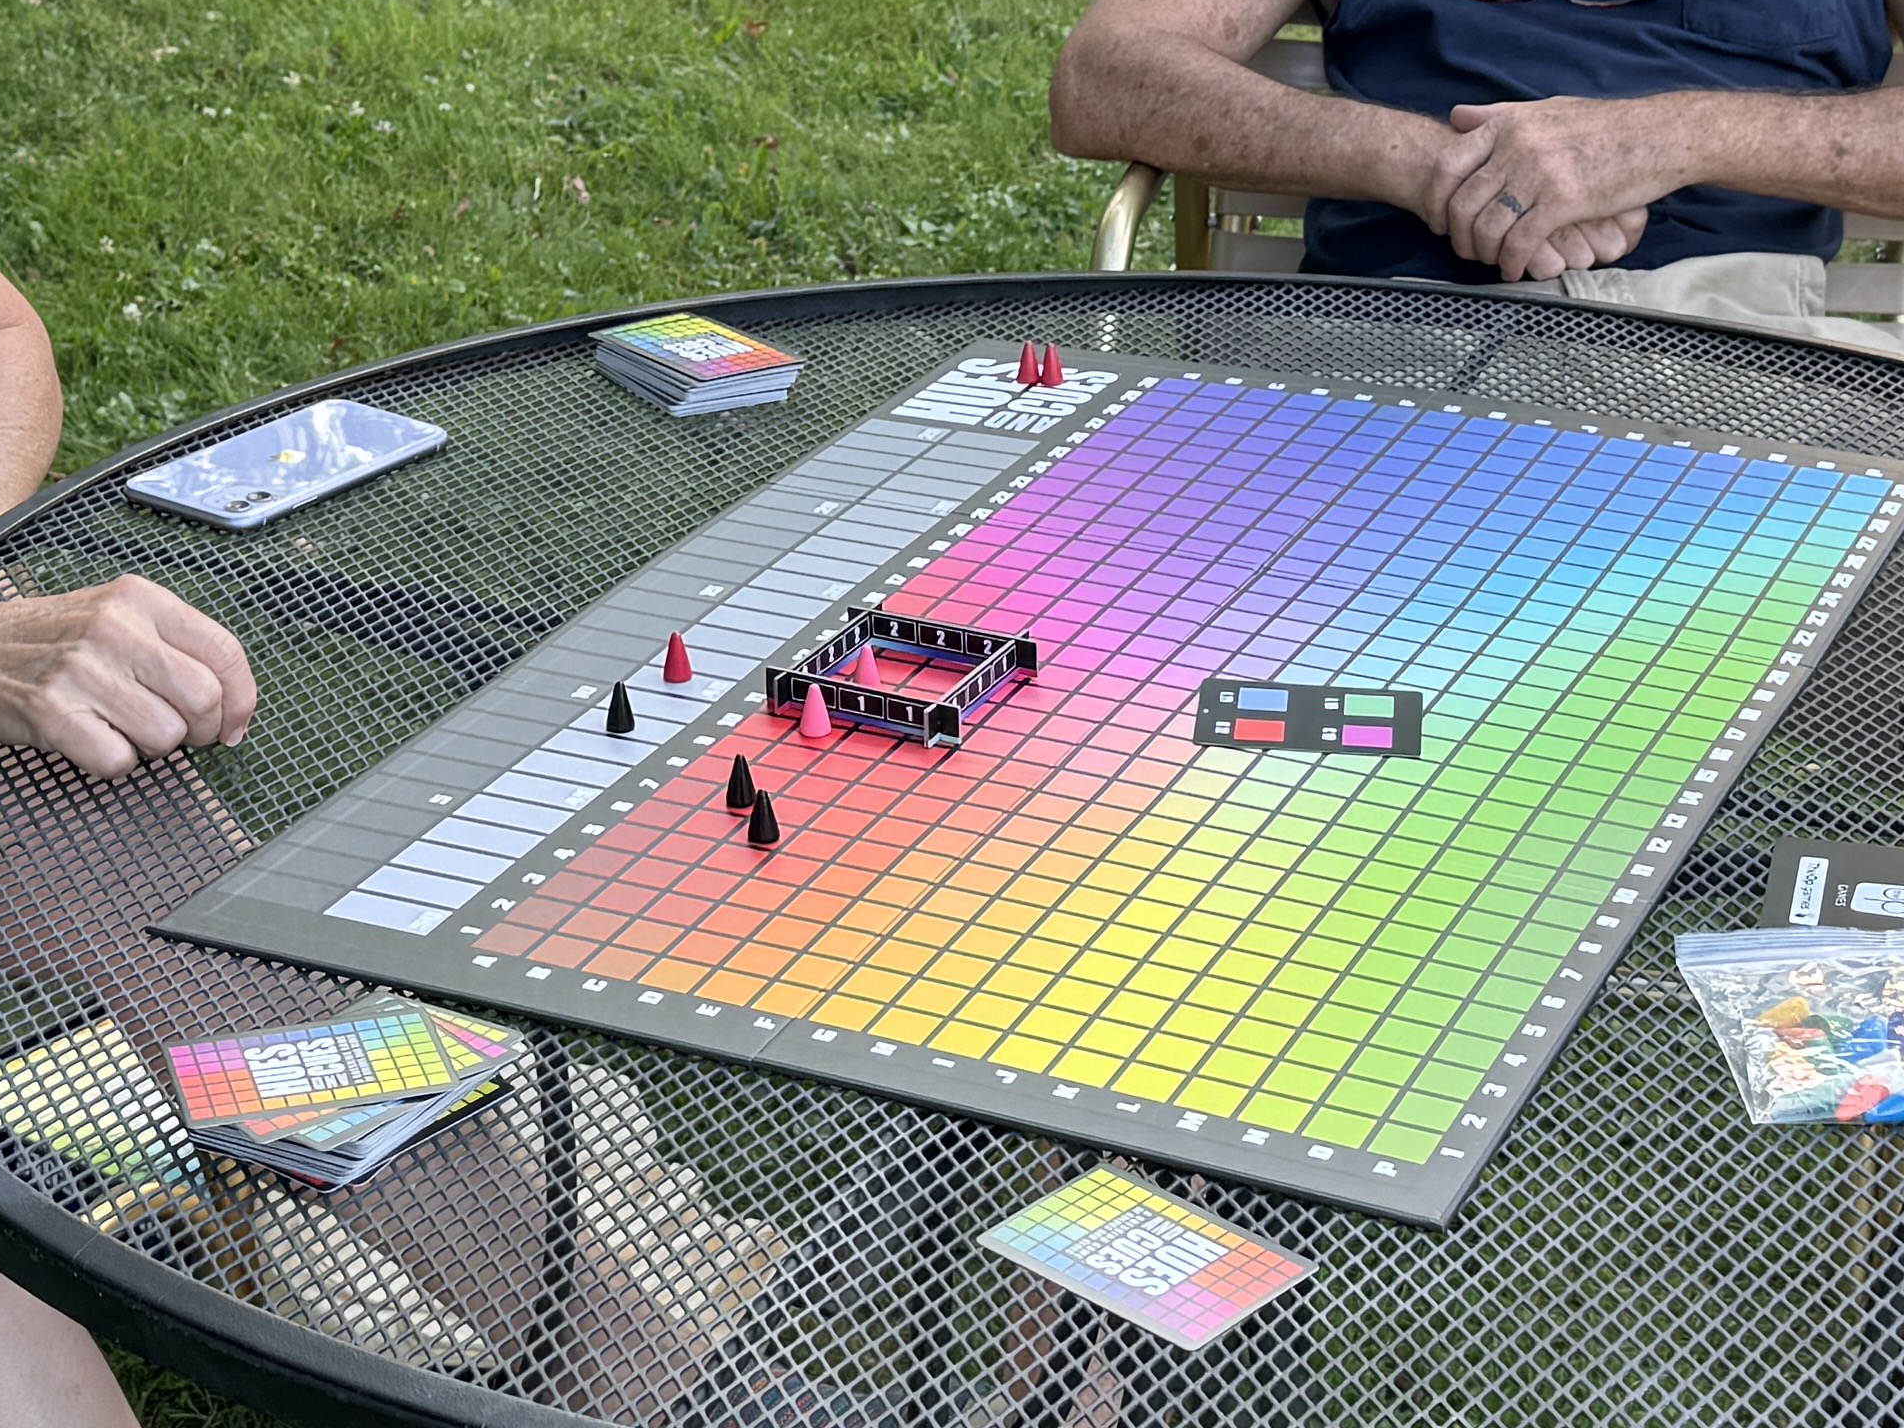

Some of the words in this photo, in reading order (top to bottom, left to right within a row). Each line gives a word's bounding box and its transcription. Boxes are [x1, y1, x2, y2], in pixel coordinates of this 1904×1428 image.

[984, 411, 1062, 434] AND
[889, 620, 899, 637] 2
[936, 629, 946, 647] 2
[857, 695, 866, 712] 1
[905, 705, 914, 722] 1
[243, 1042, 314, 1099] HUES
[296, 1036, 346, 1077] CUES
[1085, 1227, 1165, 1274] CUES
[1118, 1230, 1230, 1297] HUES
